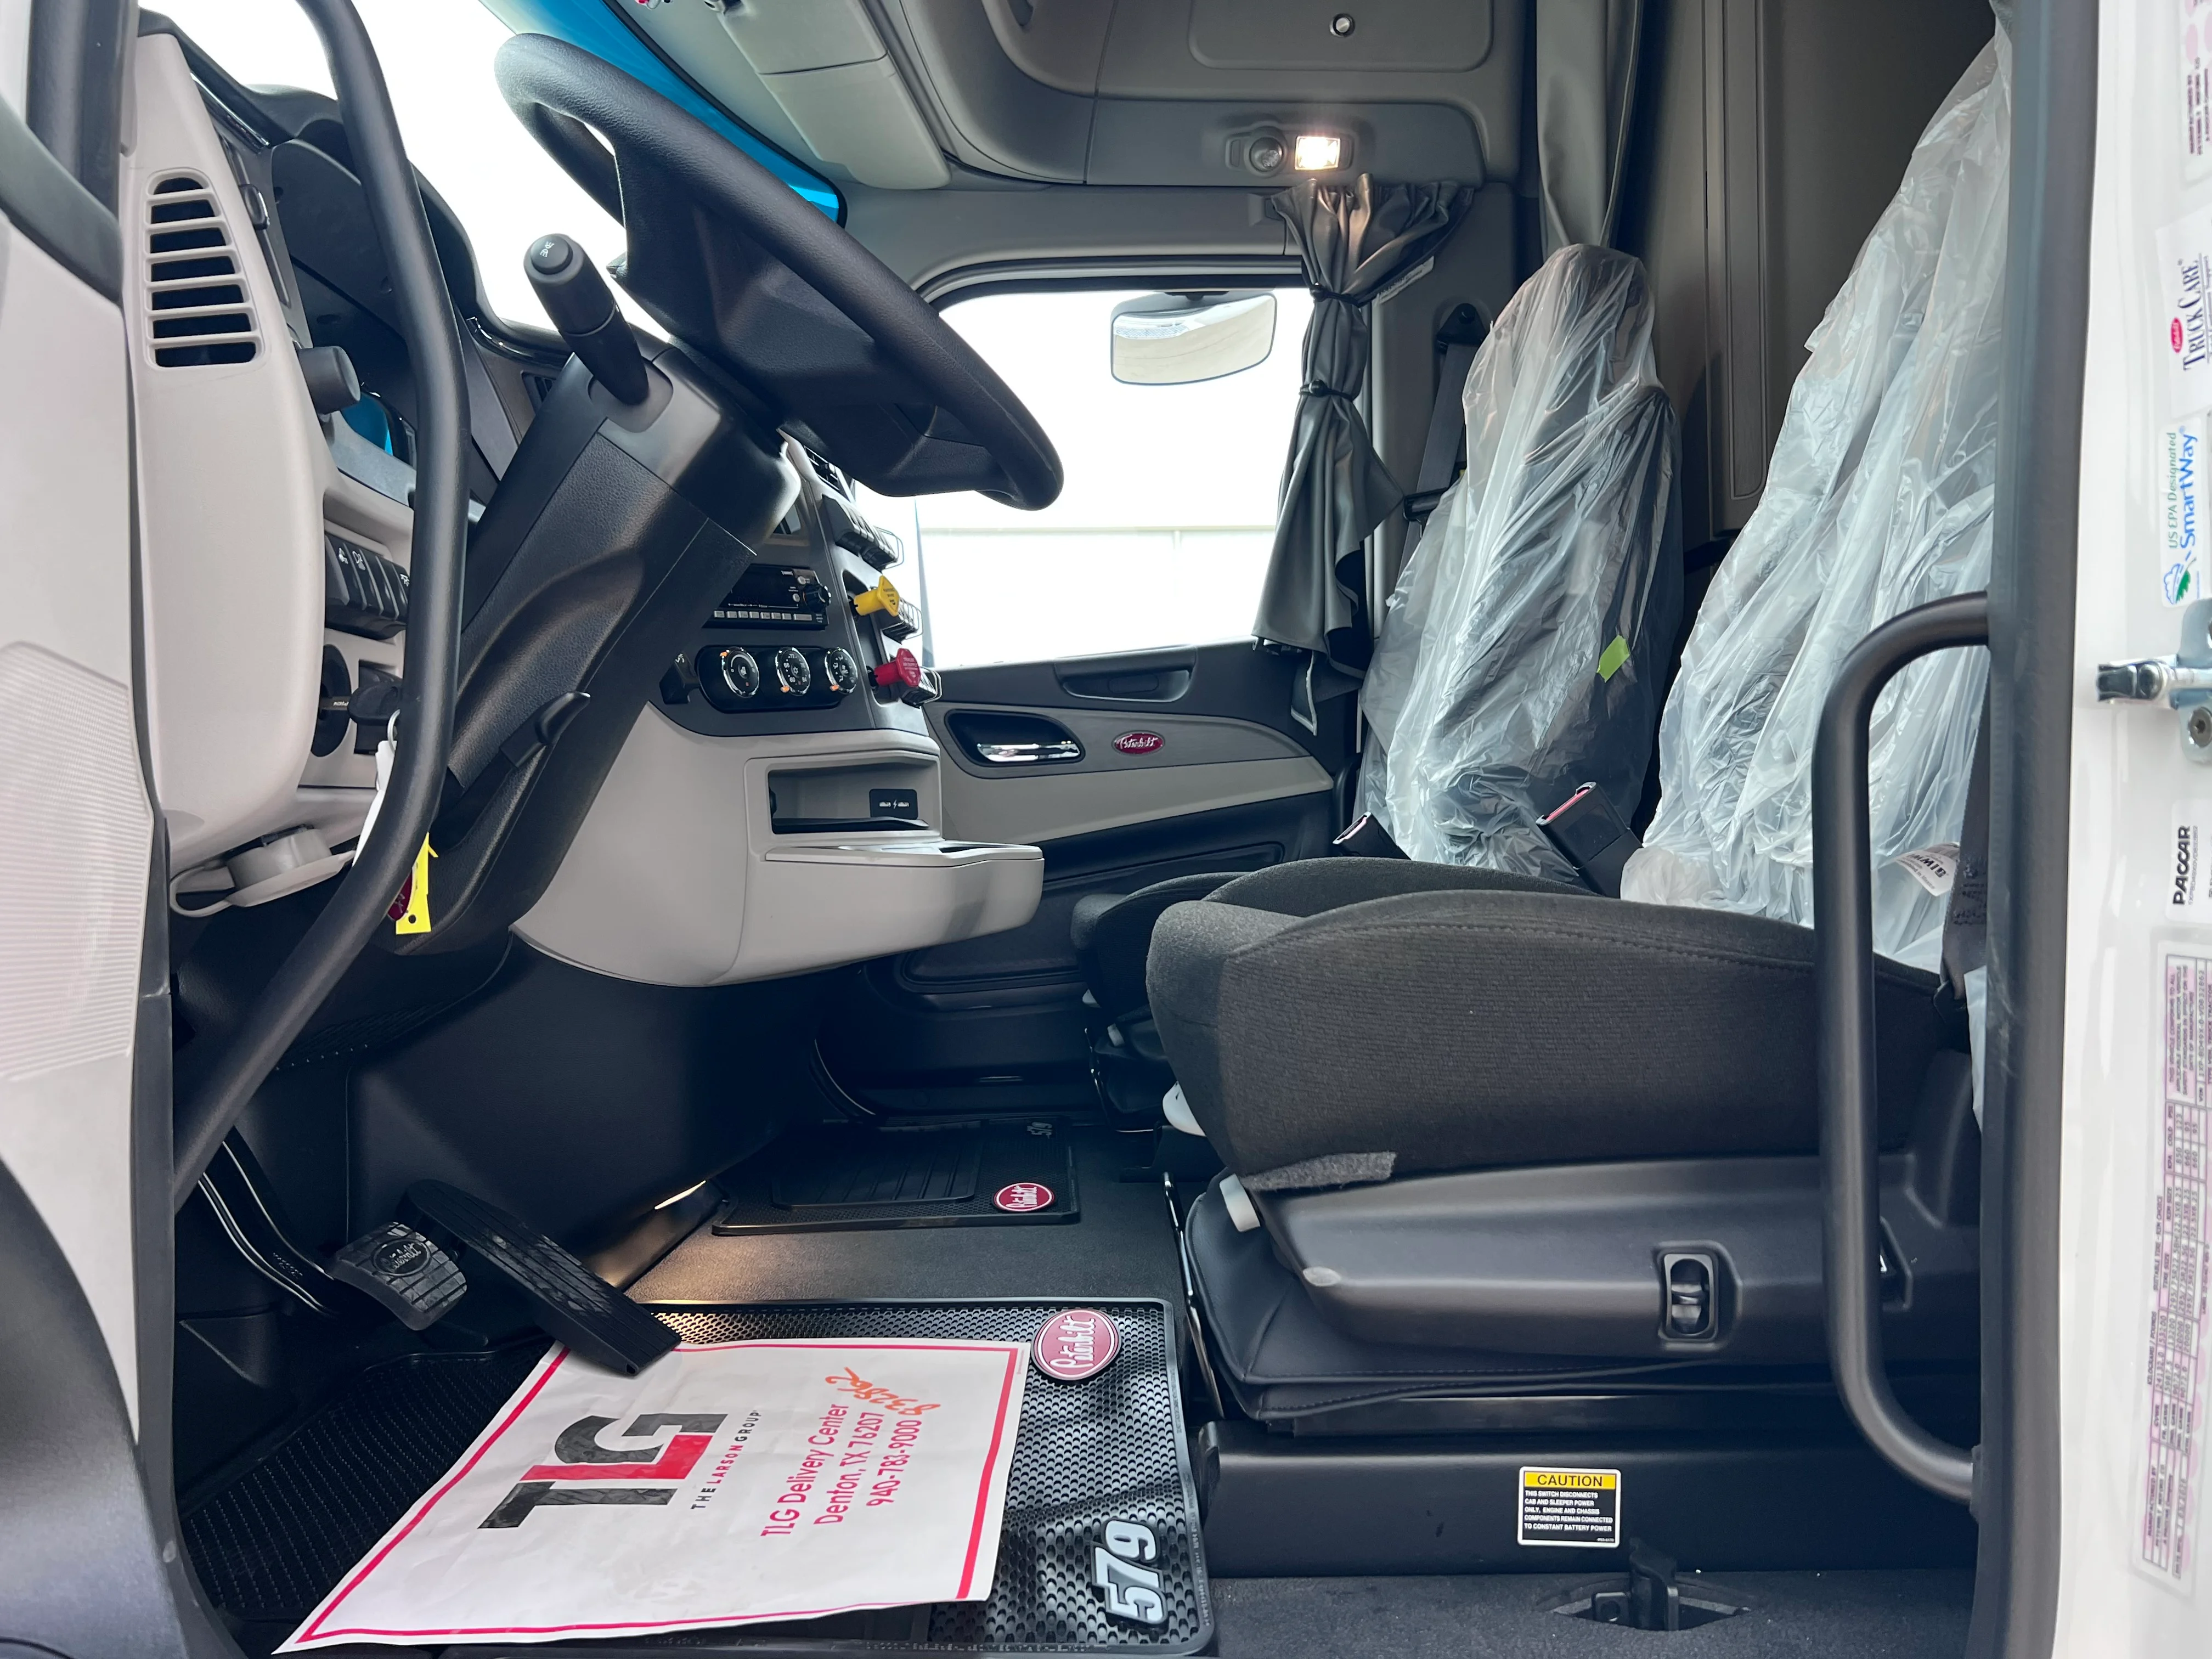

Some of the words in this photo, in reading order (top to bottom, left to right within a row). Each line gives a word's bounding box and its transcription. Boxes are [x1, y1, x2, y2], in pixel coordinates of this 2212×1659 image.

[2177, 261, 2201, 308] CARE
[2182, 308, 2205, 371] TRUCK
[2166, 432, 2179, 501] Designated
[2179, 432, 2198, 549] SmartWay
[2168, 504, 2177, 528] EPA
[2168, 532, 2178, 548] US
[2172, 826, 2190, 905] PACCAR
[1050, 1314, 1097, 1369] Peterbilt
[808, 1404, 849, 1445] Center
[848, 1412, 885, 1448] 76207
[477, 1414, 728, 1528] TLG
[690, 1487, 716, 1510] THE
[707, 1445, 743, 1484] LARSON
[735, 1412, 761, 1442] GROUP
[777, 1448, 834, 1503] Delivery
[839, 1451, 871, 1466] TX
[866, 1420, 922, 1506] 940-783-9000
[1537, 1474, 1602, 1487] CAUTION
[760, 1508, 800, 1536] TLG
[814, 1469, 866, 1525] Denton,
[1094, 1519, 1165, 1624] 579
